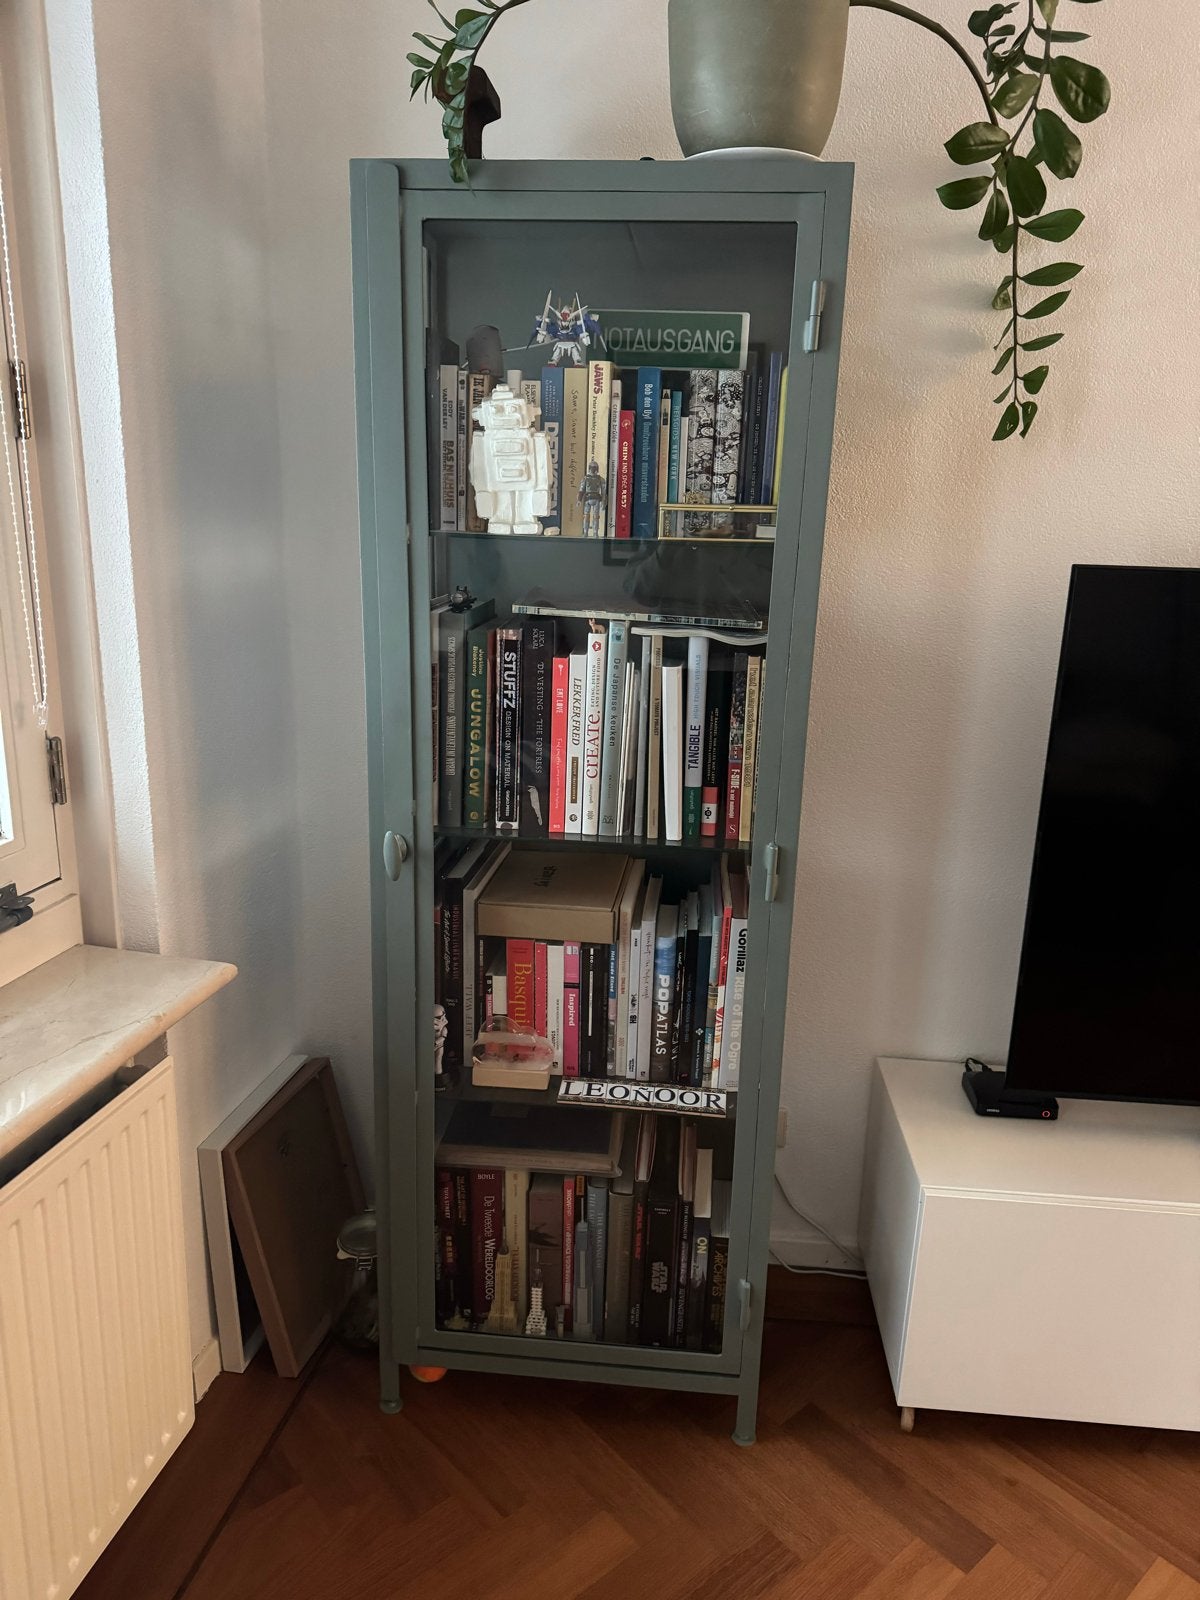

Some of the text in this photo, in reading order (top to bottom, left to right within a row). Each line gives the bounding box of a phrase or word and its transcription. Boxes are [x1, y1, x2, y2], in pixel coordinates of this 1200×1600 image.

[593, 327, 735, 354] NOTAUSGANG
[473, 377, 485, 387] IK
[593, 364, 604, 395] JAWS
[642, 383, 653, 420] Bob den Uyl
[670, 405, 680, 481] REISGIDS NEW YORK
[446, 440, 455, 508] BAS NIJHUIS
[544, 422, 560, 516] DERKEN
[641, 462, 650, 504] misverstanden
[471, 646, 480, 678] Blakeney
[503, 651, 516, 709] STUFFZ
[694, 654, 702, 681] VISUALS
[556, 688, 564, 699] EAT
[571, 678, 582, 746] LEKKERFRED
[609, 658, 622, 747] De Japanse keuken
[504, 711, 512, 738] DESIGN
[534, 662, 544, 774] DE VESTING THE FORTRESS
[746, 689, 756, 738] aanzien
[446, 716, 456, 757] INTERVENTIONS
[469, 688, 482, 798] JUNGALOW
[504, 739, 512, 751] ON
[688, 724, 701, 770] TANGIBLE
[744, 738, 754, 761] van
[446, 758, 456, 776] URBAN
[503, 752, 511, 789] MATERIAL
[730, 769, 741, 789] F-SIDE
[465, 984, 473, 1039] JEFF WALL
[509, 962, 532, 1025] Basqui
[568, 993, 576, 1026] Inspired
[726, 928, 748, 1070] Gorillaz Rise of the Ogre
[484, 1196, 496, 1301] De Tweede WERELDOORLOG
[697, 1237, 708, 1254] ON
[651, 1261, 661, 1291] WARS
[660, 1264, 669, 1293] STAR
[712, 1250, 724, 1297] ARCHIVES
